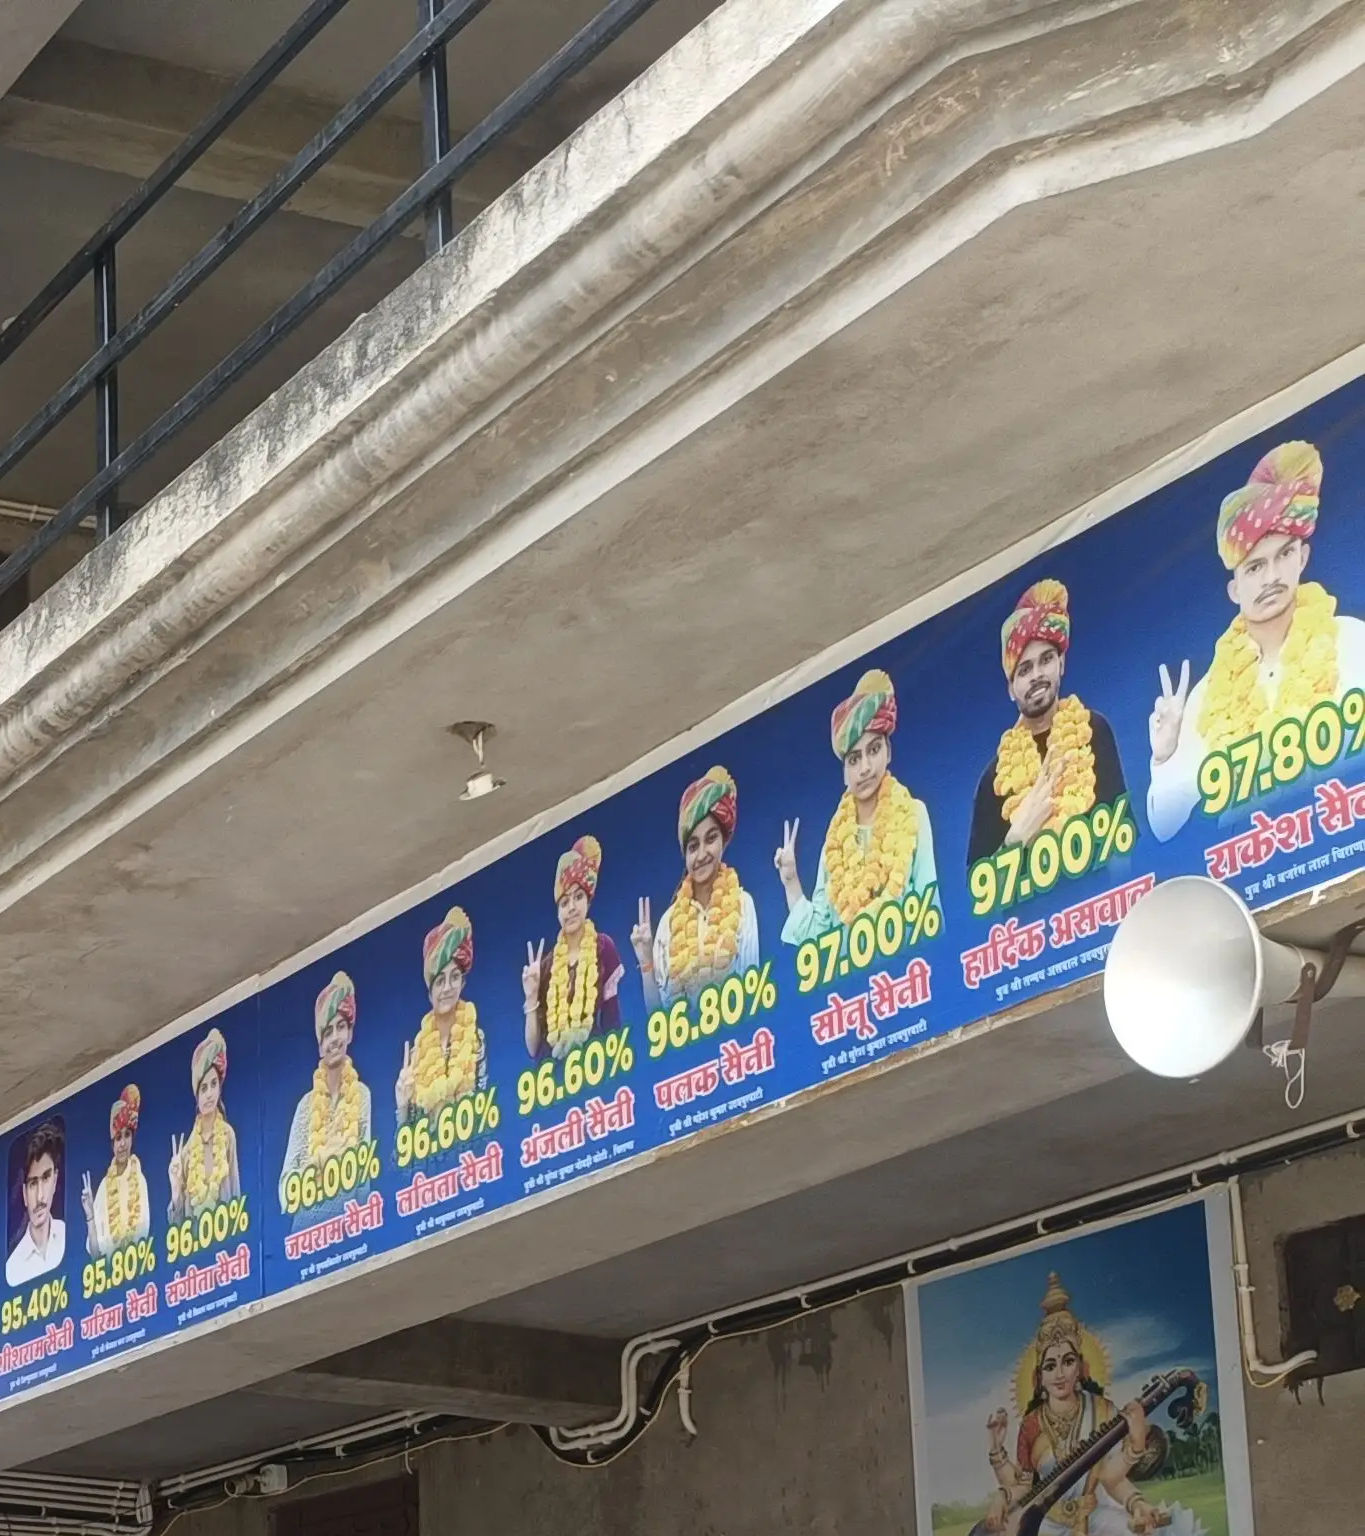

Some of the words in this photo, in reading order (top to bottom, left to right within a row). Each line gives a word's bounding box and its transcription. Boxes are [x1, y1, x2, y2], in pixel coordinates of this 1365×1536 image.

[971, 798, 1135, 916] 97.00%
[1204, 811, 1313, 881] राकेश
[796, 890, 939, 992] 97.00%
[961, 918, 1045, 989] हार्दिक
[647, 962, 777, 1059] 96.80%
[810, 992, 876, 1044] सोनू
[872, 958, 932, 1020] सैनी
[517, 1026, 633, 1115] 96.60%
[654, 1062, 719, 1110] पलक
[720, 1028, 775, 1084] सैनी
[397, 1088, 500, 1168] 96.60%
[520, 1111, 587, 1168] अंजली
[586, 1087, 635, 1144] सैनी
[284, 1140, 380, 1214] 96.00%
[396, 1171, 459, 1217] ललिता
[458, 1142, 503, 1194] सैनी
[166, 1196, 249, 1263] 96.00%
[285, 1217, 344, 1261] जयराम
[342, 1192, 384, 1239] सैनी
[0, 1275, 68, 1334] 95.40%
[82, 1237, 156, 1299] 95.80%
[165, 1264, 216, 1307] संगीता
[214, 1243, 251, 1286] सैनी
[45, 1317, 74, 1355] सैनी
[80, 1304, 123, 1340] गरिमा
[126, 1283, 158, 1323] सैनी
